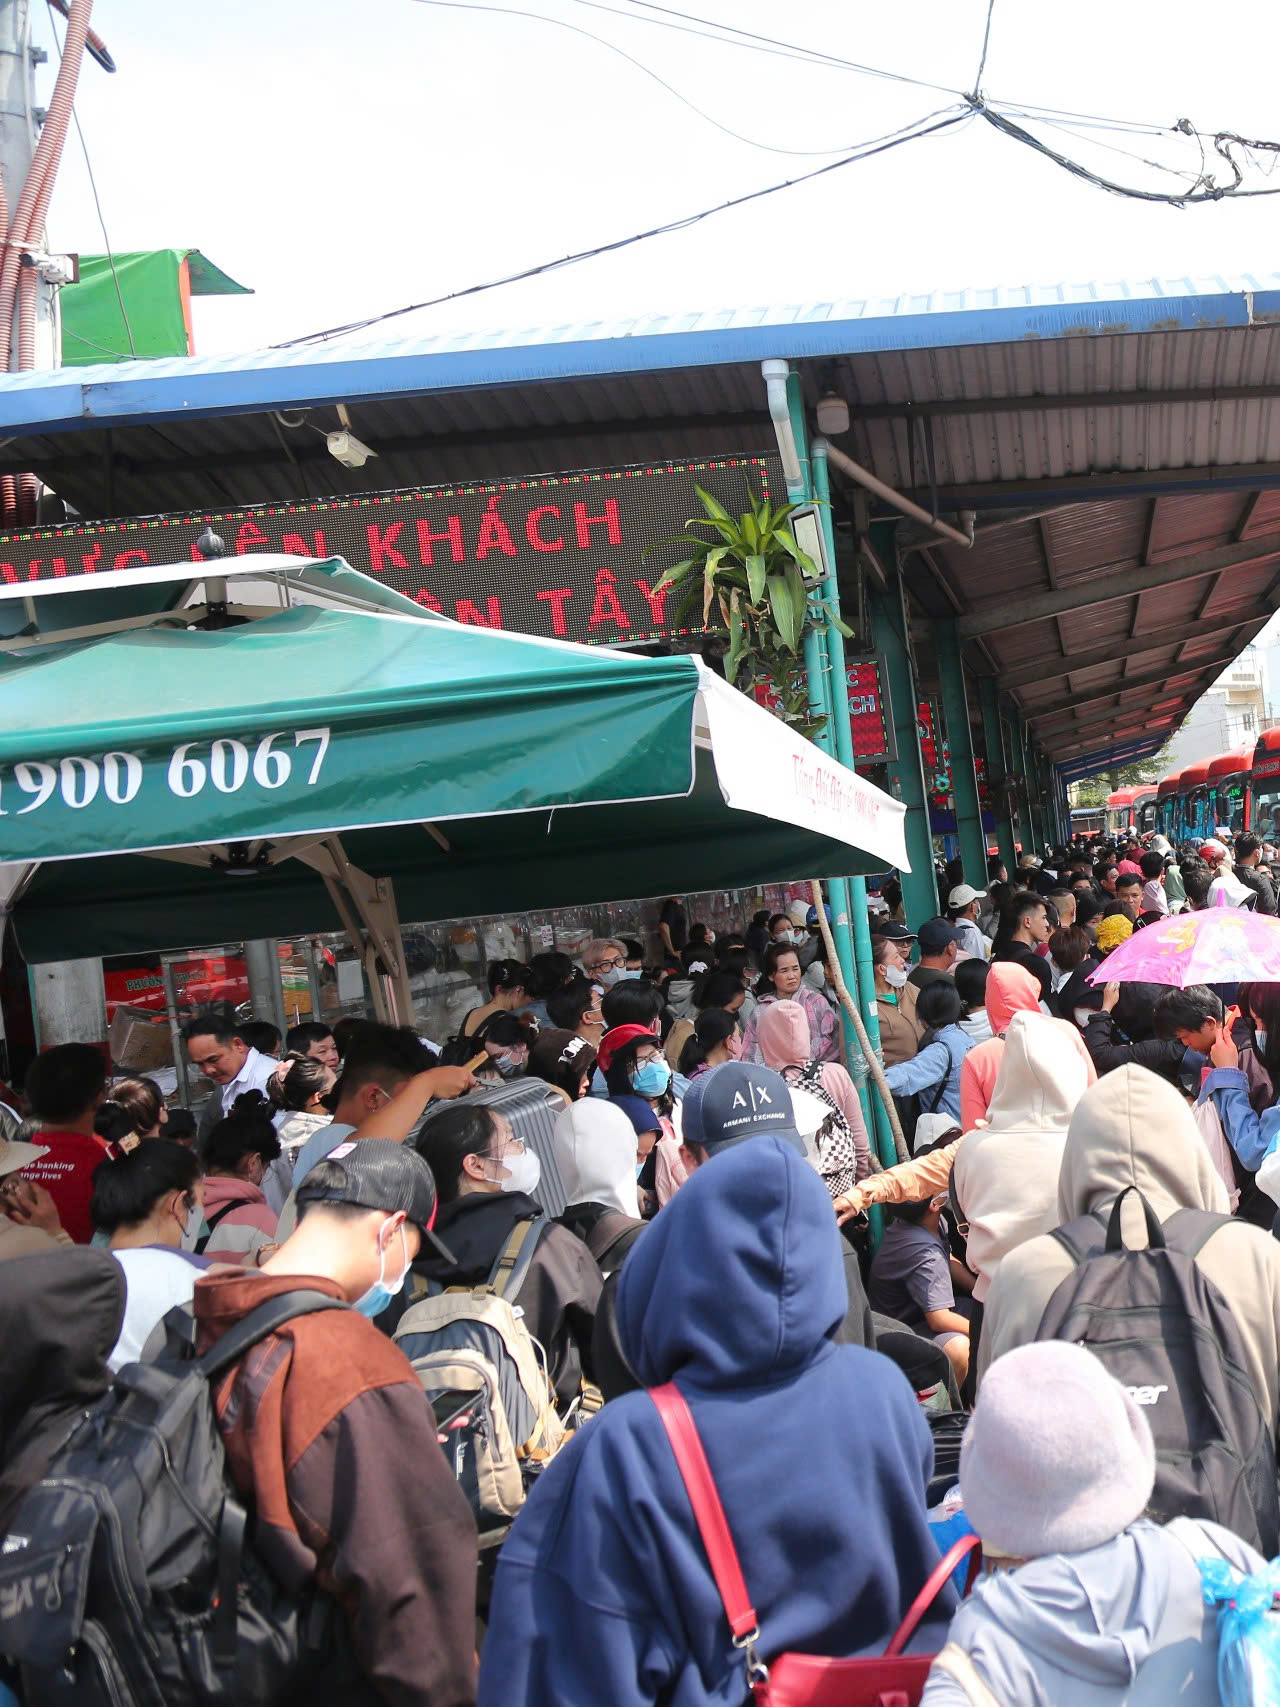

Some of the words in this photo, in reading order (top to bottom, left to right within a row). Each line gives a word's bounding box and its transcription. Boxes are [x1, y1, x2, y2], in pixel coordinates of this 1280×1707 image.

[365, 495, 623, 571] KHÁCH
[536, 568, 677, 636] TÂY
[167, 727, 330, 798] 6067
[723, 1116, 751, 1129] ARMANI
[37, 1161, 75, 1171] banking
[42, 1171, 62, 1180] lives
